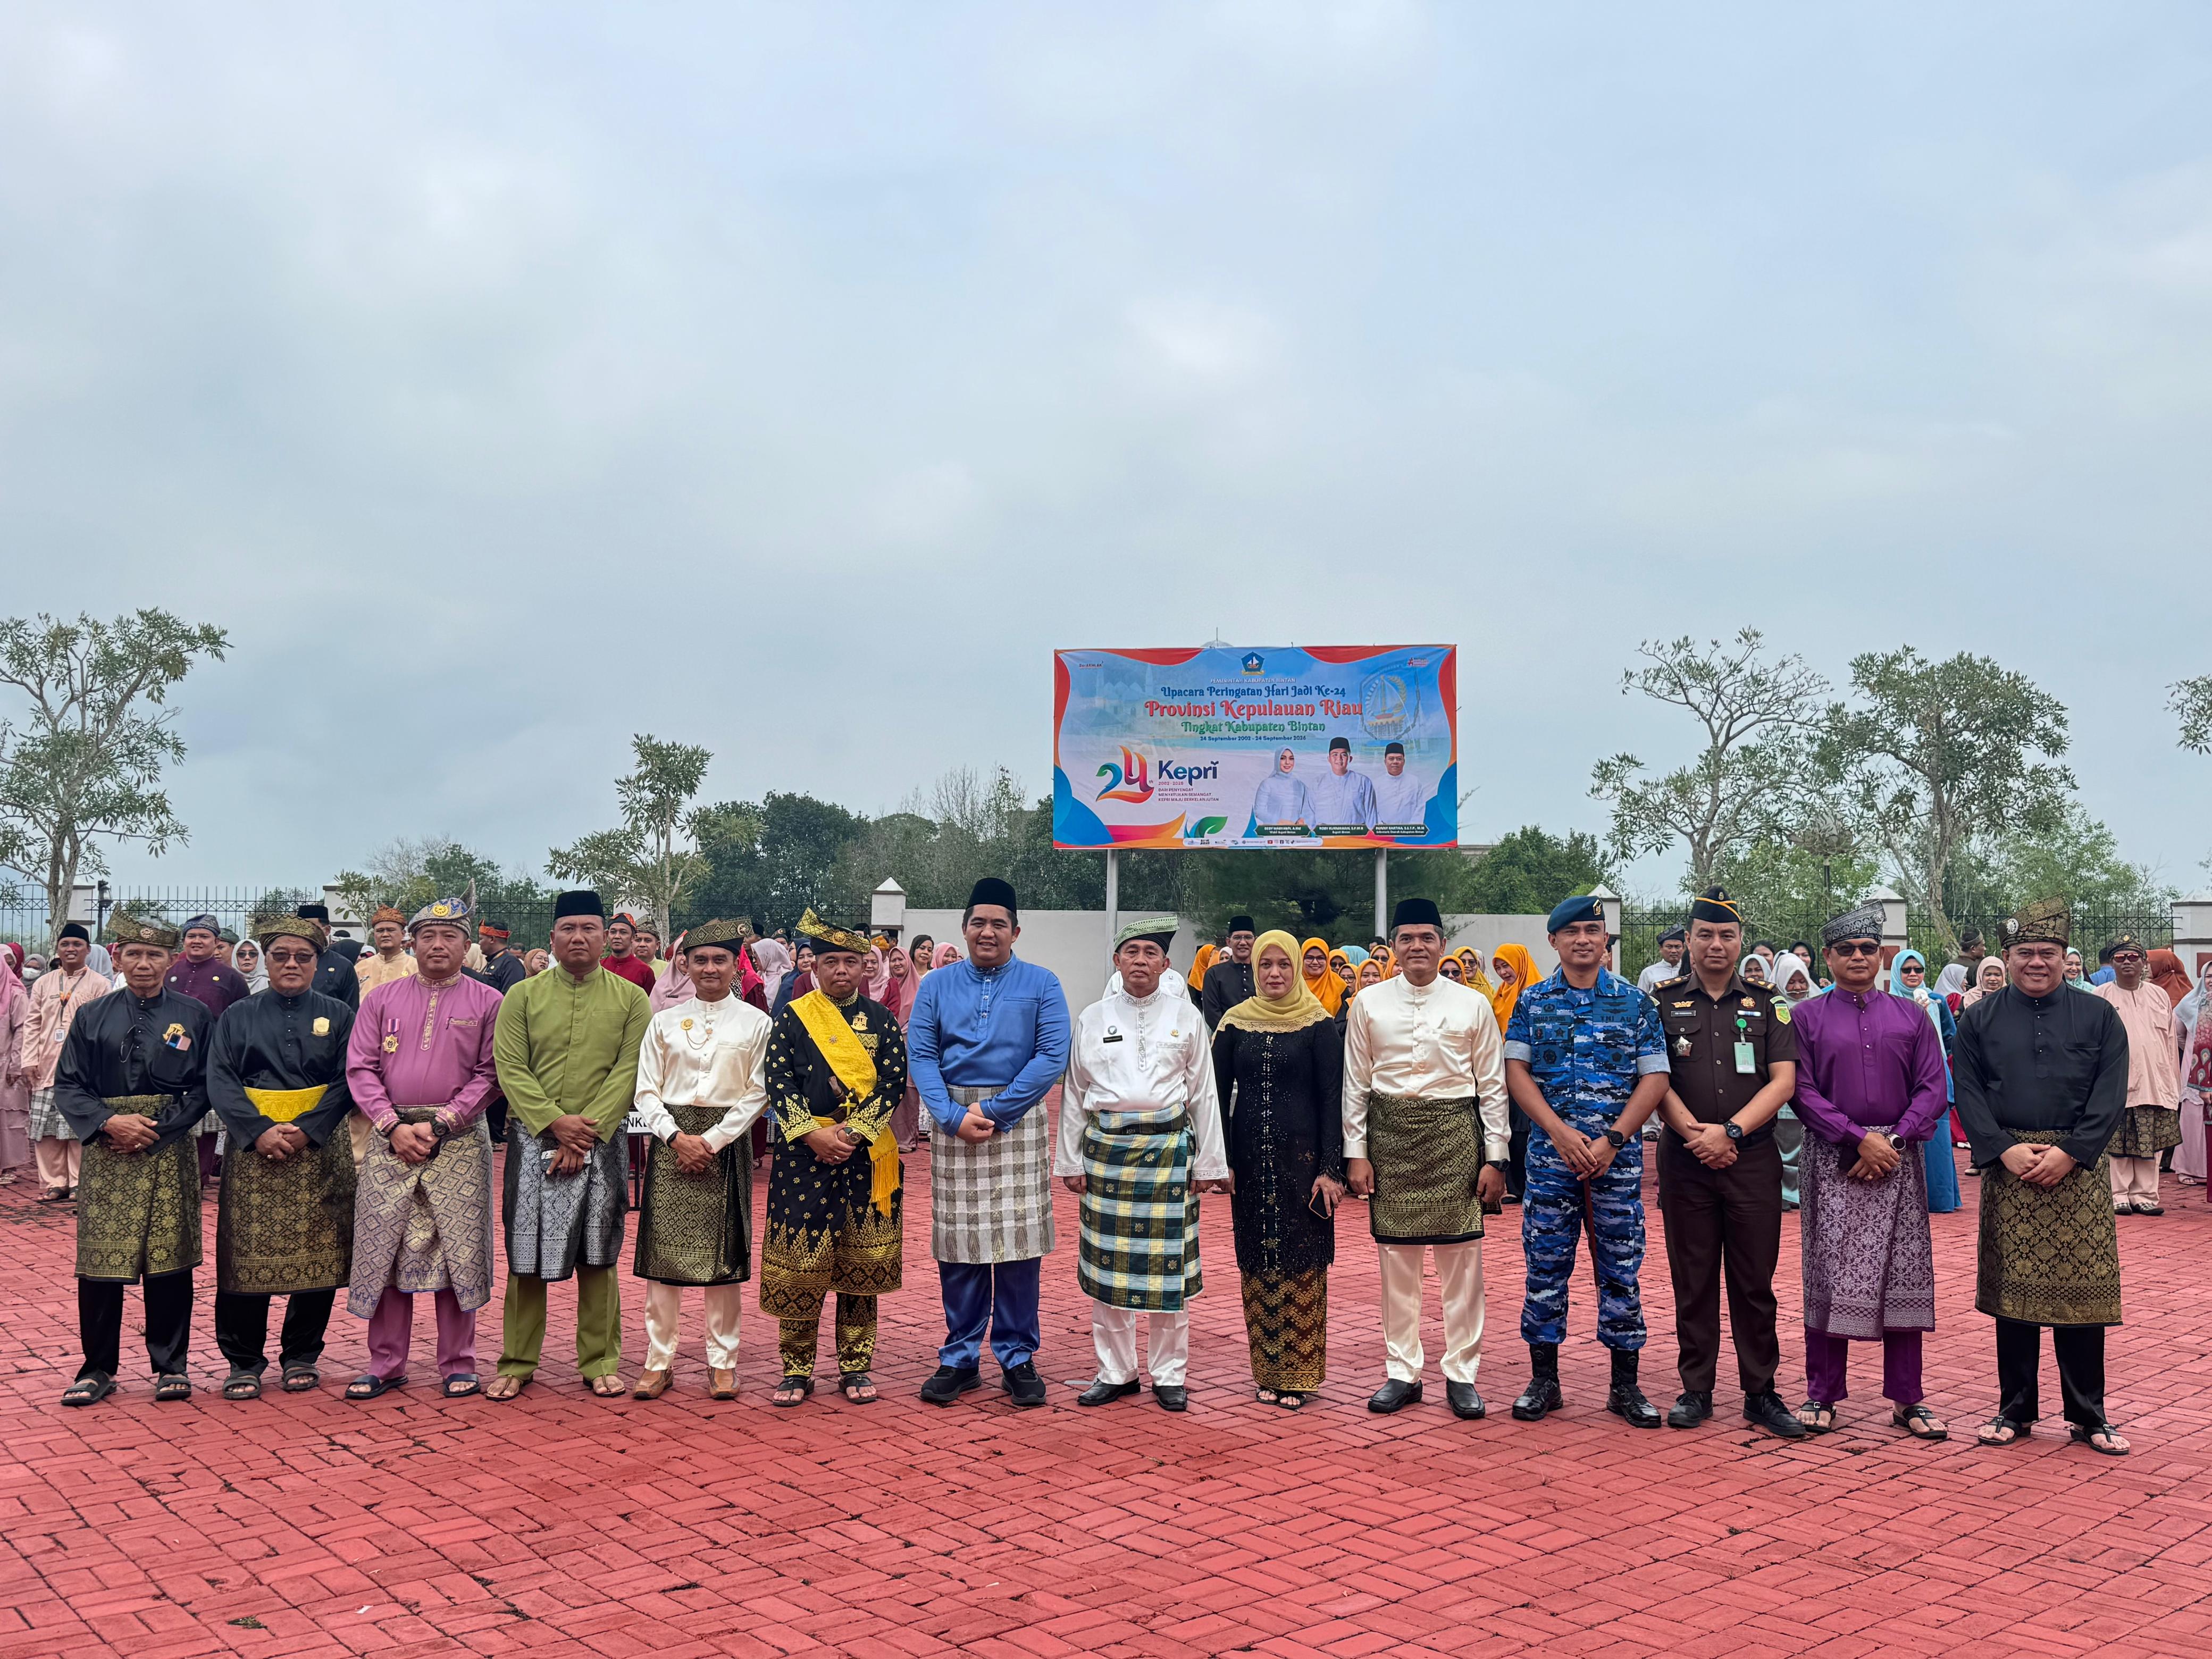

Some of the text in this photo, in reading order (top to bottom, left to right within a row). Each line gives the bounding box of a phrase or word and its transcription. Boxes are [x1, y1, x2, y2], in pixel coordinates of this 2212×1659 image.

[1161, 684, 1346, 699] Upacara Peringatan Hari Jadi Ke-24
[1144, 699, 1363, 721] Provinsi Kepulauan Riau
[1181, 720, 1326, 734] Tingkat Kabupaten Bintan
[1158, 760, 1219, 786] Kepri
